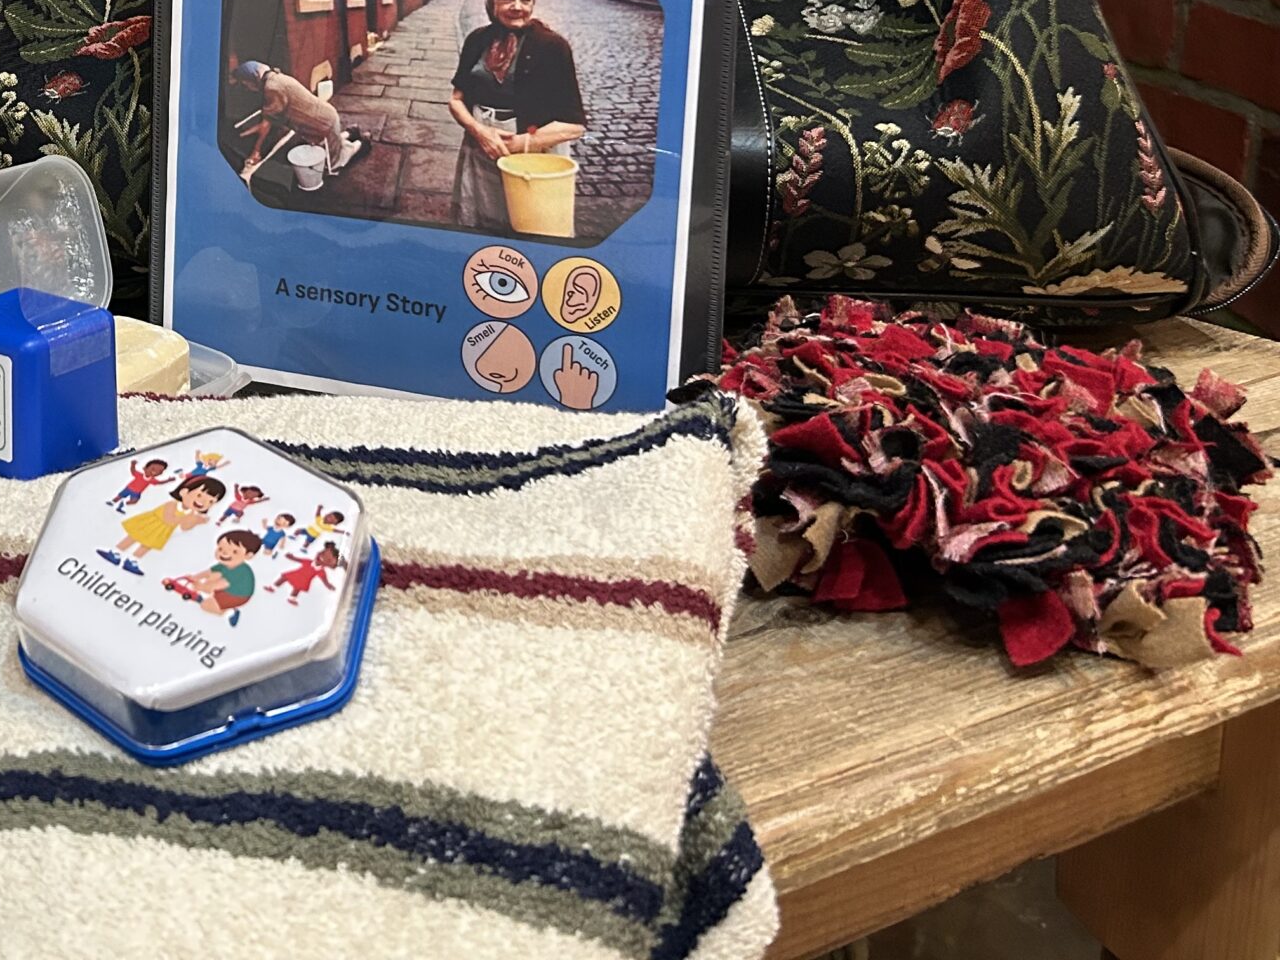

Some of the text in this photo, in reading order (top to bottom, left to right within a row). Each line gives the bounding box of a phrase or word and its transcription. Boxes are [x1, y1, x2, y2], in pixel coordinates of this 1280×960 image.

[497, 248, 526, 270] Look
[275, 277, 448, 324] A sensory Story
[584, 303, 617, 331] Listen
[466, 323, 497, 349] Smell
[577, 340, 610, 371] Touch
[56, 556, 228, 669] Children playing
